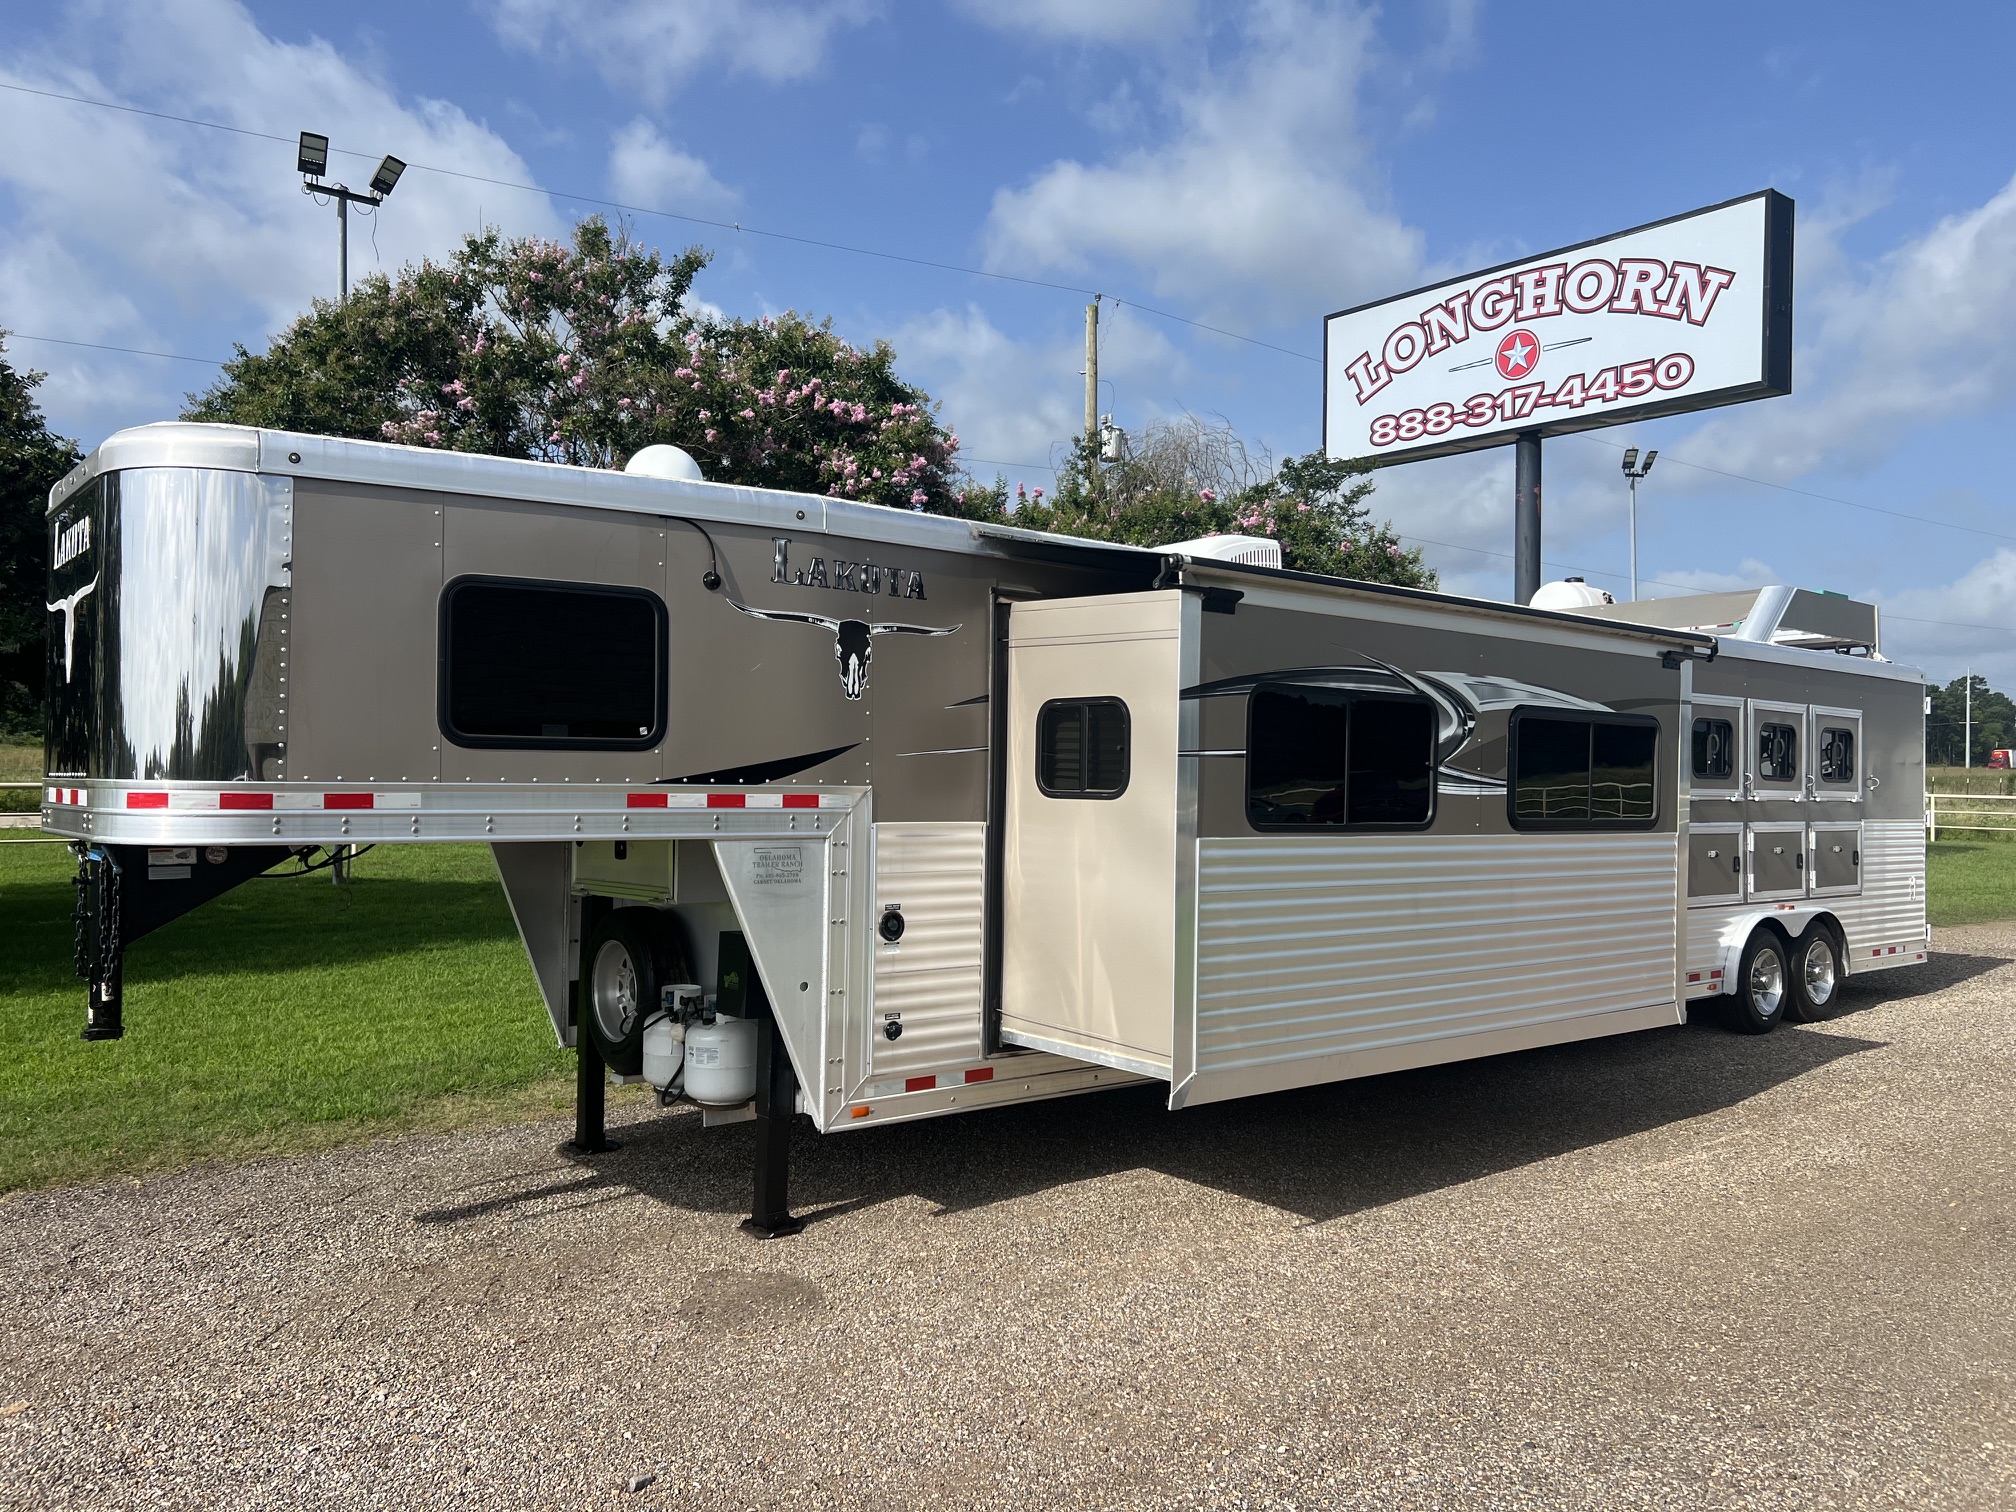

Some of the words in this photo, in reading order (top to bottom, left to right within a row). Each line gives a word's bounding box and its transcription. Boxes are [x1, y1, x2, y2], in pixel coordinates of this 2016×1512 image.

[1345, 258, 1736, 406] LONGHORN
[1370, 353, 1695, 446] 888-317-4450
[53, 515, 91, 570] LAKOTA
[770, 536, 927, 600] LAKOTA
[781, 860, 803, 868] RANCH
